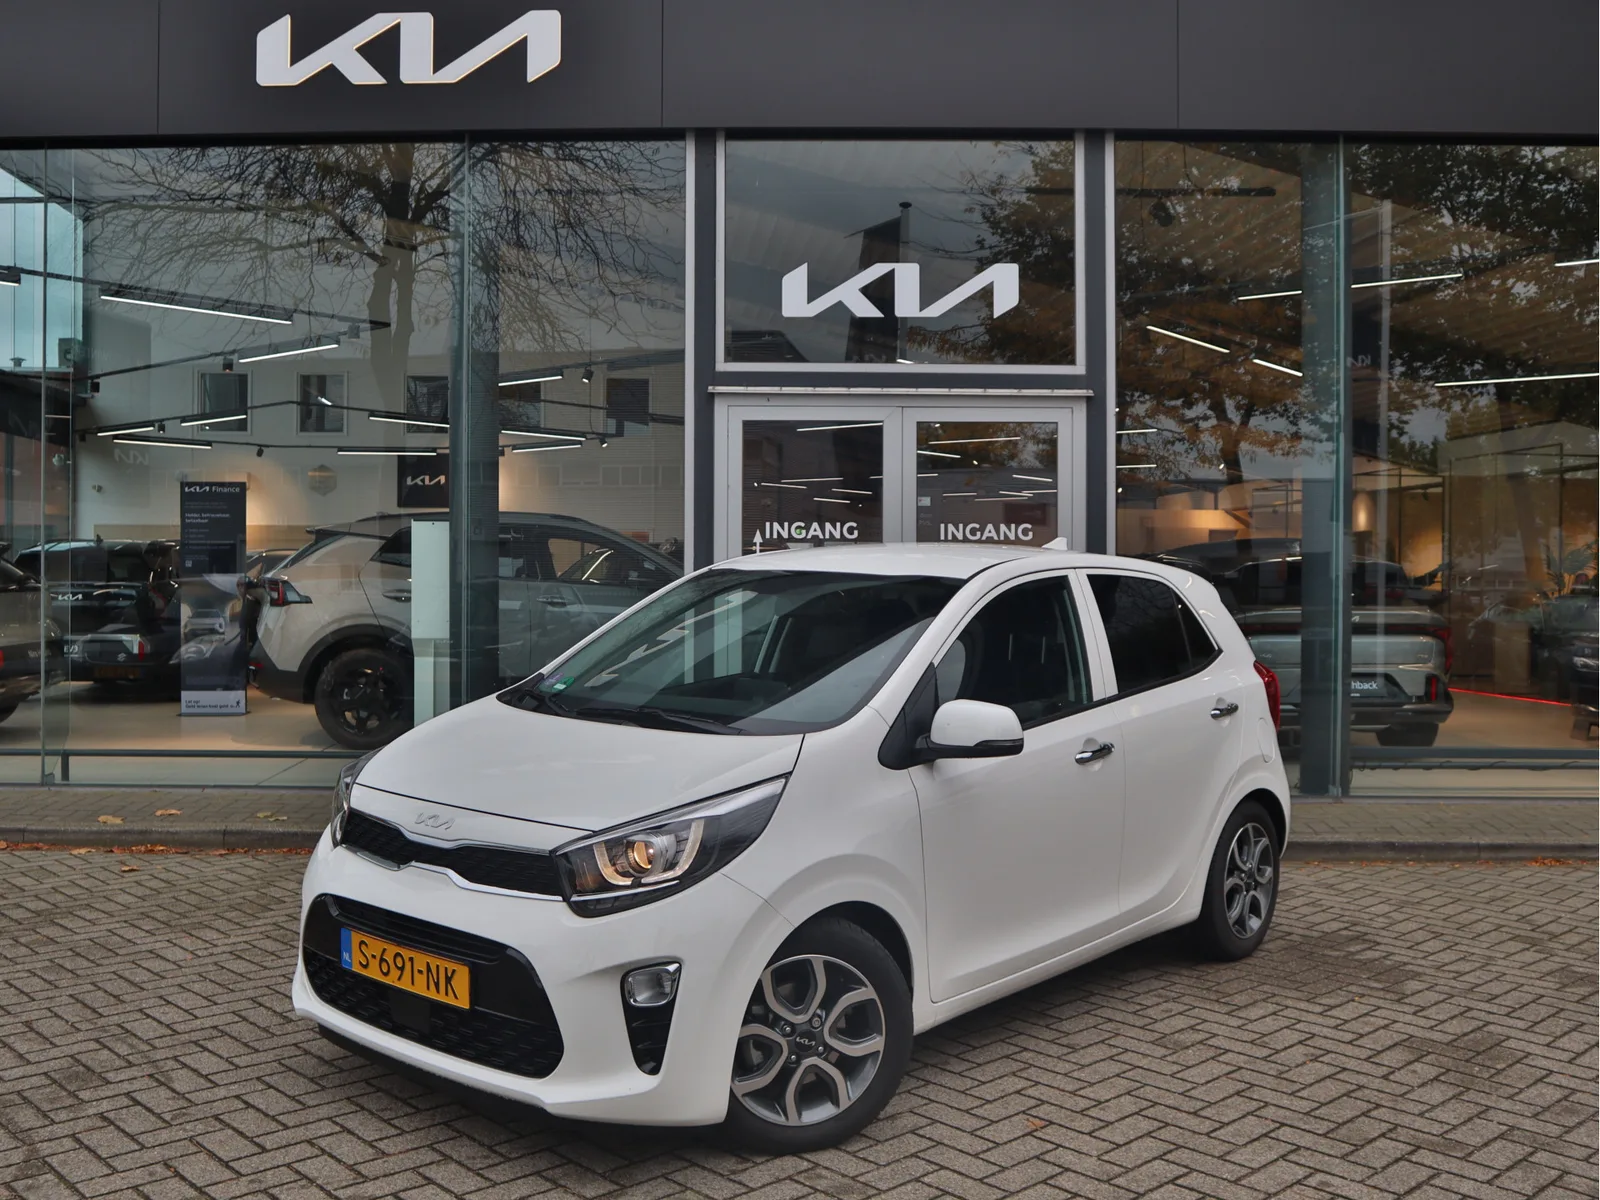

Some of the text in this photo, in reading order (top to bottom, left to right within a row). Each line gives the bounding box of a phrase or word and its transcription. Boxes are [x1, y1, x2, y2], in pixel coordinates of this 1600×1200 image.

[256, 10, 561, 86] KIA
[782, 262, 1019, 318] KIA
[406, 475, 446, 485] KIA
[765, 521, 859, 540] INGANG
[940, 523, 1033, 541] INGANG
[58, 593, 83, 601] KIA
[414, 812, 456, 831] KIA
[343, 952, 351, 962] NL
[358, 939, 459, 1000] S-691-NK
[796, 1036, 816, 1047] KIA
